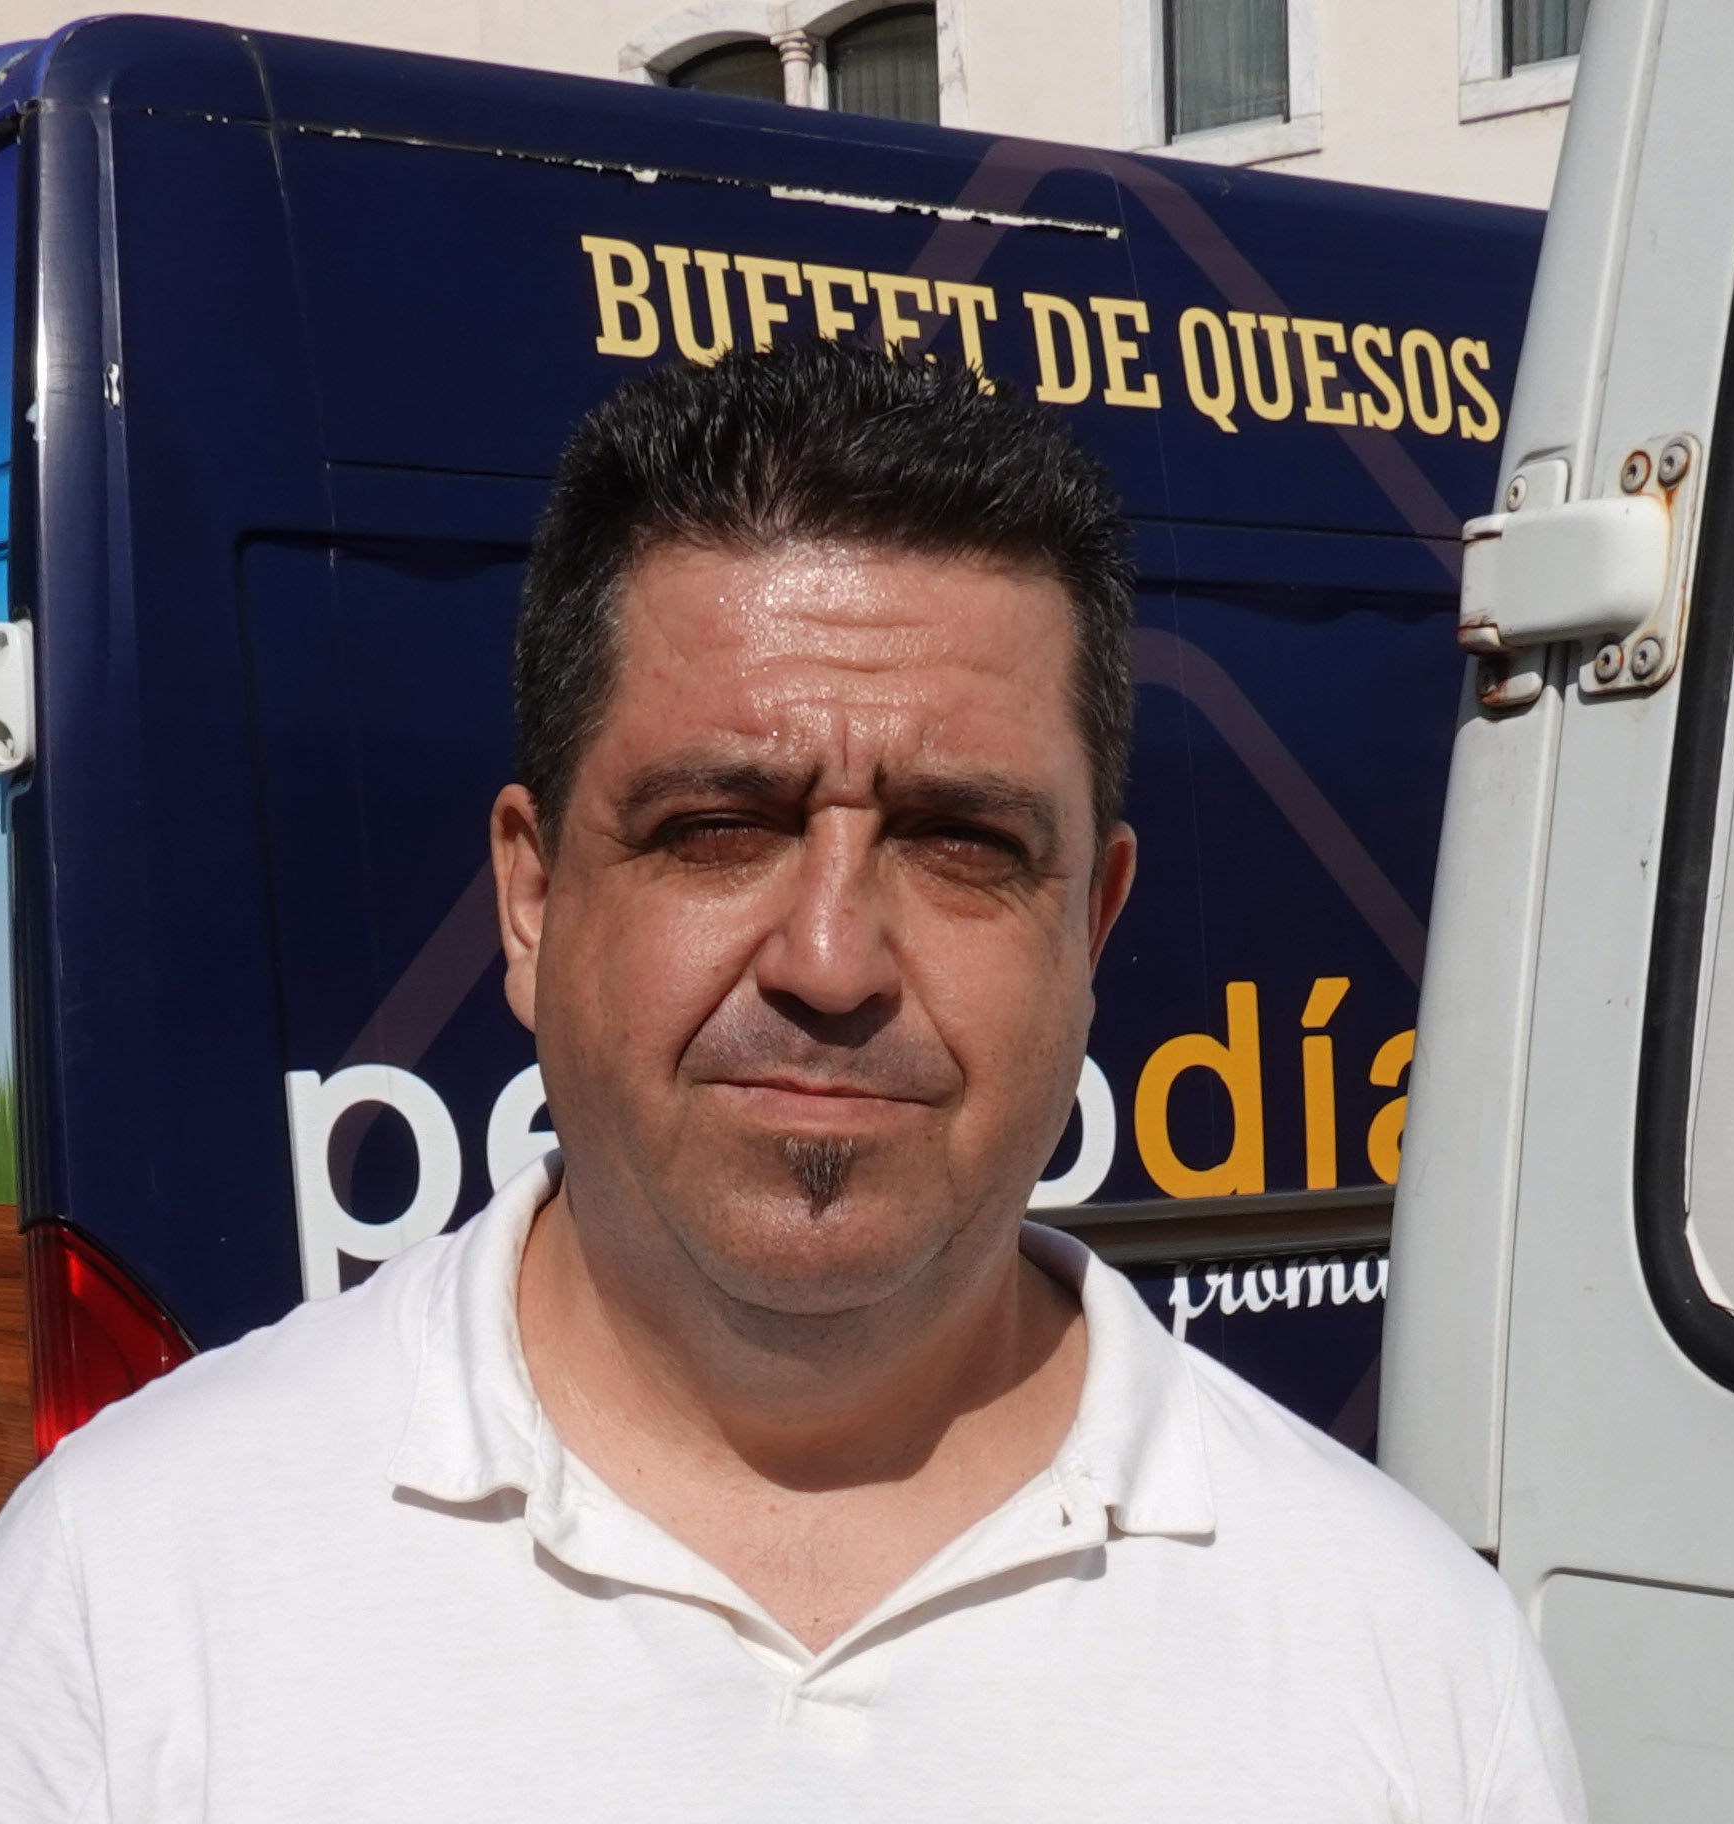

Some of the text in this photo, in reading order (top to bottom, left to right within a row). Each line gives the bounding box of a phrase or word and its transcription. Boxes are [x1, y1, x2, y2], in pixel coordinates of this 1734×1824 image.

[581, 233, 1501, 443] BUFFET DE QUESOS
